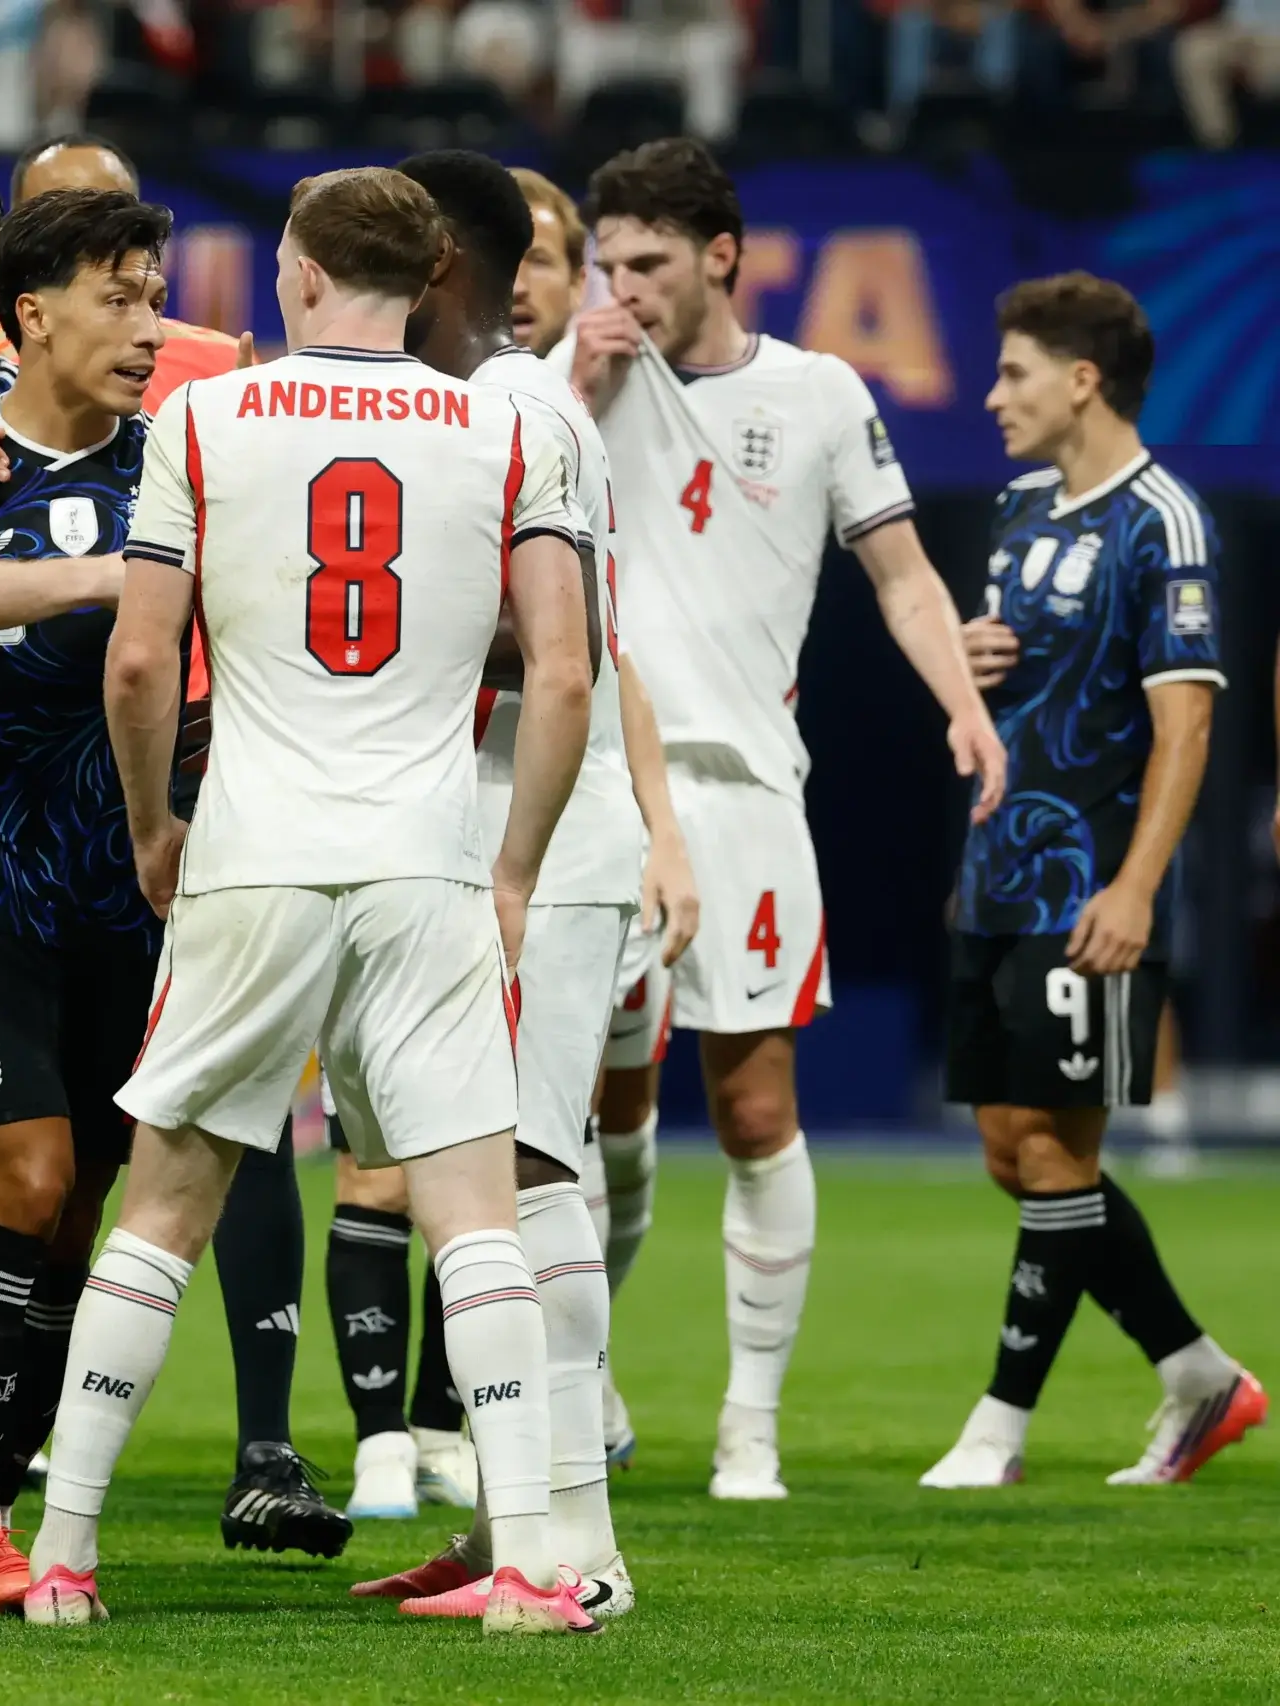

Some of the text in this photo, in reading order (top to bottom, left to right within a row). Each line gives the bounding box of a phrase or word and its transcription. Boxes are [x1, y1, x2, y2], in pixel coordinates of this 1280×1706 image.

[236, 380, 470, 429] ANDERSON
[680, 457, 714, 534] 4
[304, 456, 403, 677] 8
[747, 890, 782, 969] 4
[1045, 966, 1089, 1045] 9
[82, 1369, 135, 1400] ENG
[473, 1380, 522, 1409] ENG
